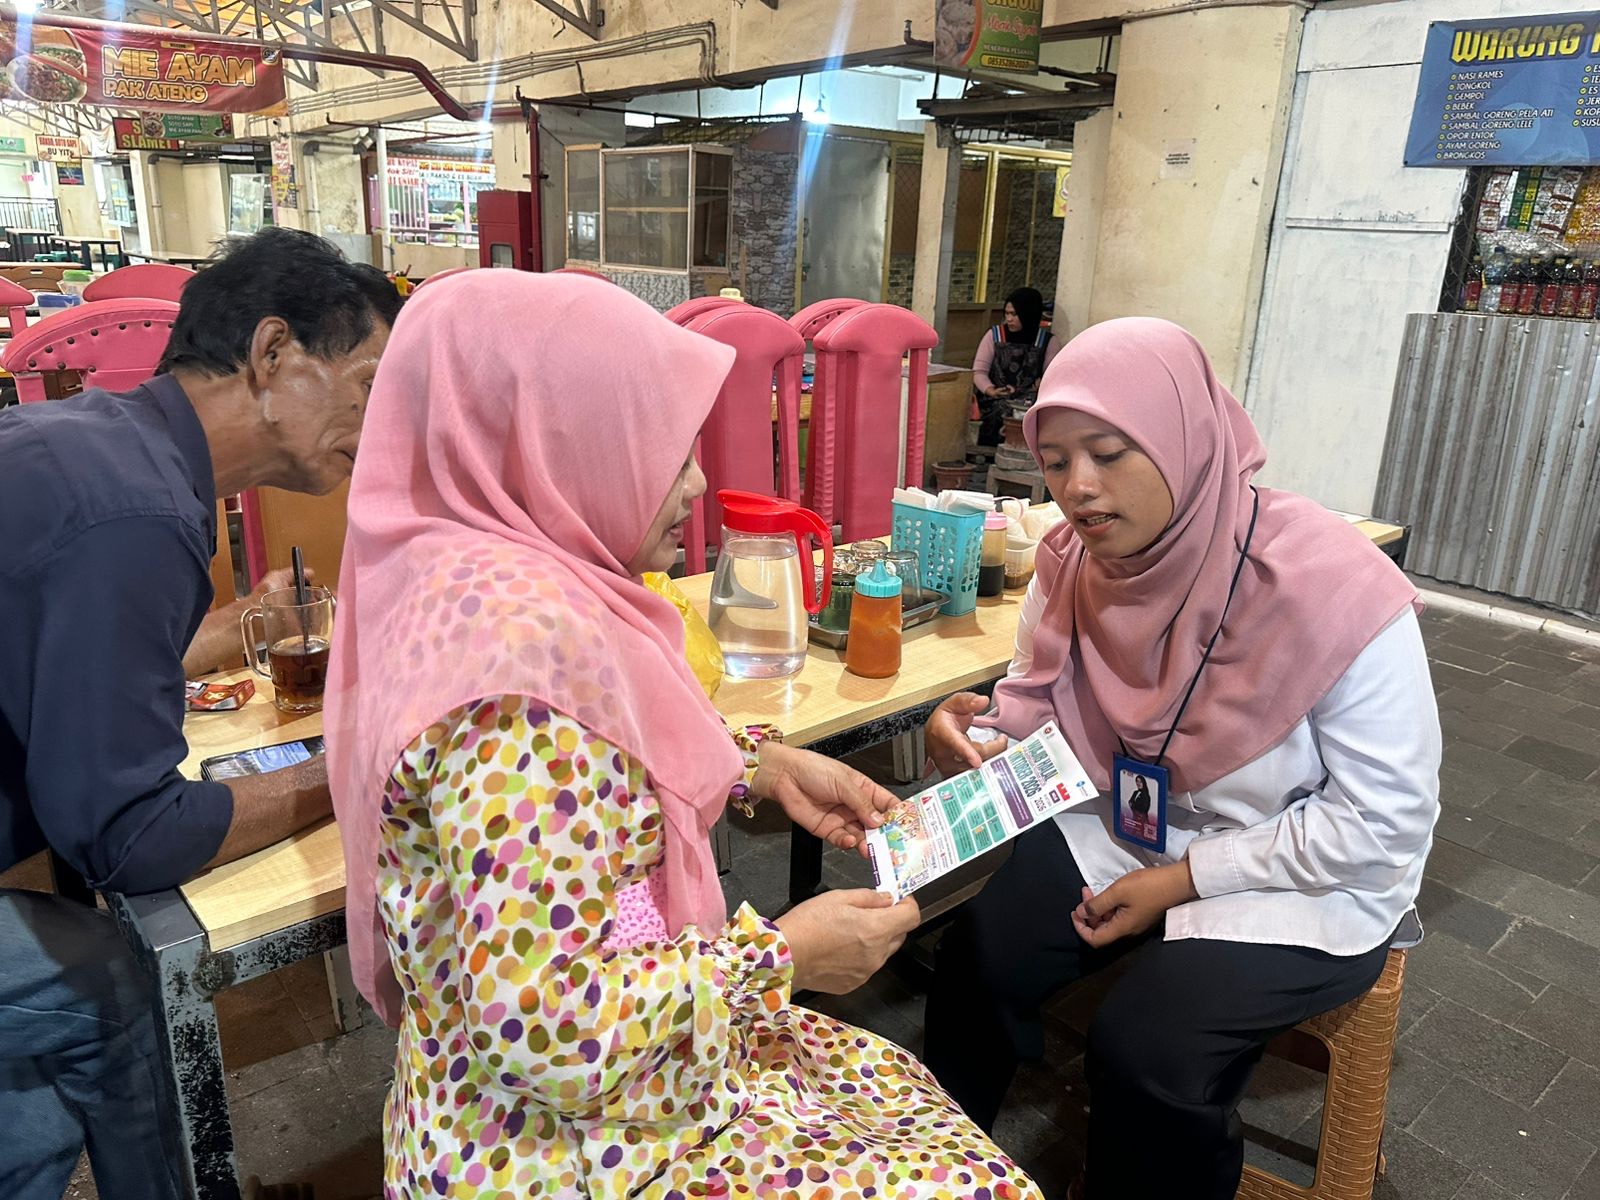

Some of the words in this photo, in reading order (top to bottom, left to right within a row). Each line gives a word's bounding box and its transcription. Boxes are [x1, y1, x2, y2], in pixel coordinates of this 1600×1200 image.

[1452, 24, 1584, 63] WARUNG
[103, 45, 158, 78] MIE
[166, 52, 255, 85] AYAM
[1478, 70, 1503, 79] RAMES
[104, 79, 144, 98] PAK
[147, 82, 207, 102] ATENG
[1456, 82, 1491, 90] TONGKOL
[1586, 97, 1600, 105] JER
[1450, 112, 1480, 120] SAMBAL
[1483, 111, 1517, 119] GORENG
[1519, 110, 1538, 118] PELA
[1541, 109, 1554, 117] ATI
[1583, 108, 1600, 116] KOP
[1449, 122, 1478, 130] SAMBAL
[1481, 121, 1514, 129] GORENG
[1516, 120, 1533, 128] LELE
[1446, 132, 1470, 140] OPOR
[1471, 131, 1495, 139] ENTOK
[122, 135, 171, 148] SLAMET
[1468, 141, 1500, 149] GORENG
[1443, 151, 1486, 159] BRONGKOS
[1027, 738, 1049, 763] WAJIB
[1008, 750, 1033, 781] OKTOBER
[1021, 776, 1041, 797] 2026
[1036, 758, 1059, 781] HALAL
